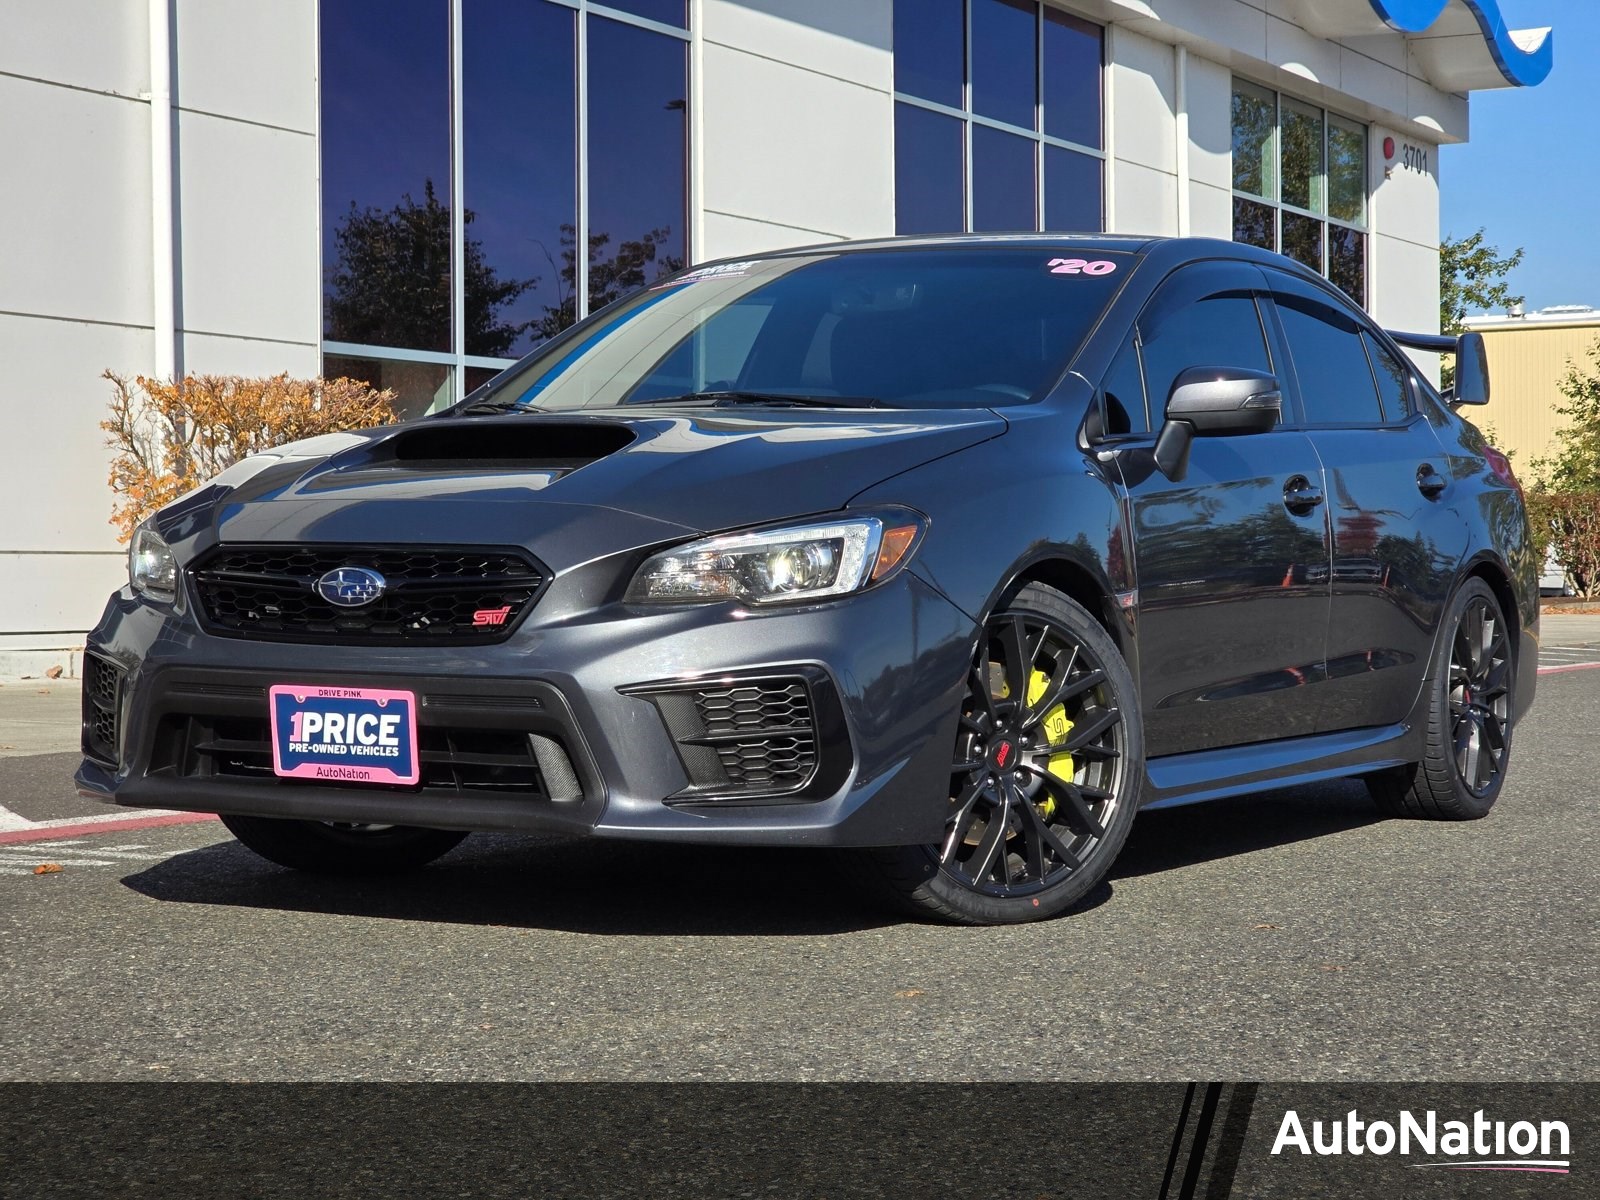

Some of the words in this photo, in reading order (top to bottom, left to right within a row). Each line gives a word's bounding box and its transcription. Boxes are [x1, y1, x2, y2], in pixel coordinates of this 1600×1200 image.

[1403, 143, 1427, 176] 3701
[318, 689, 341, 697] DRIVE
[343, 690, 362, 698] PINK
[289, 743, 347, 755] PRE-OWNED
[350, 745, 399, 757] VEHICLES
[316, 767, 370, 780] AutoNation
